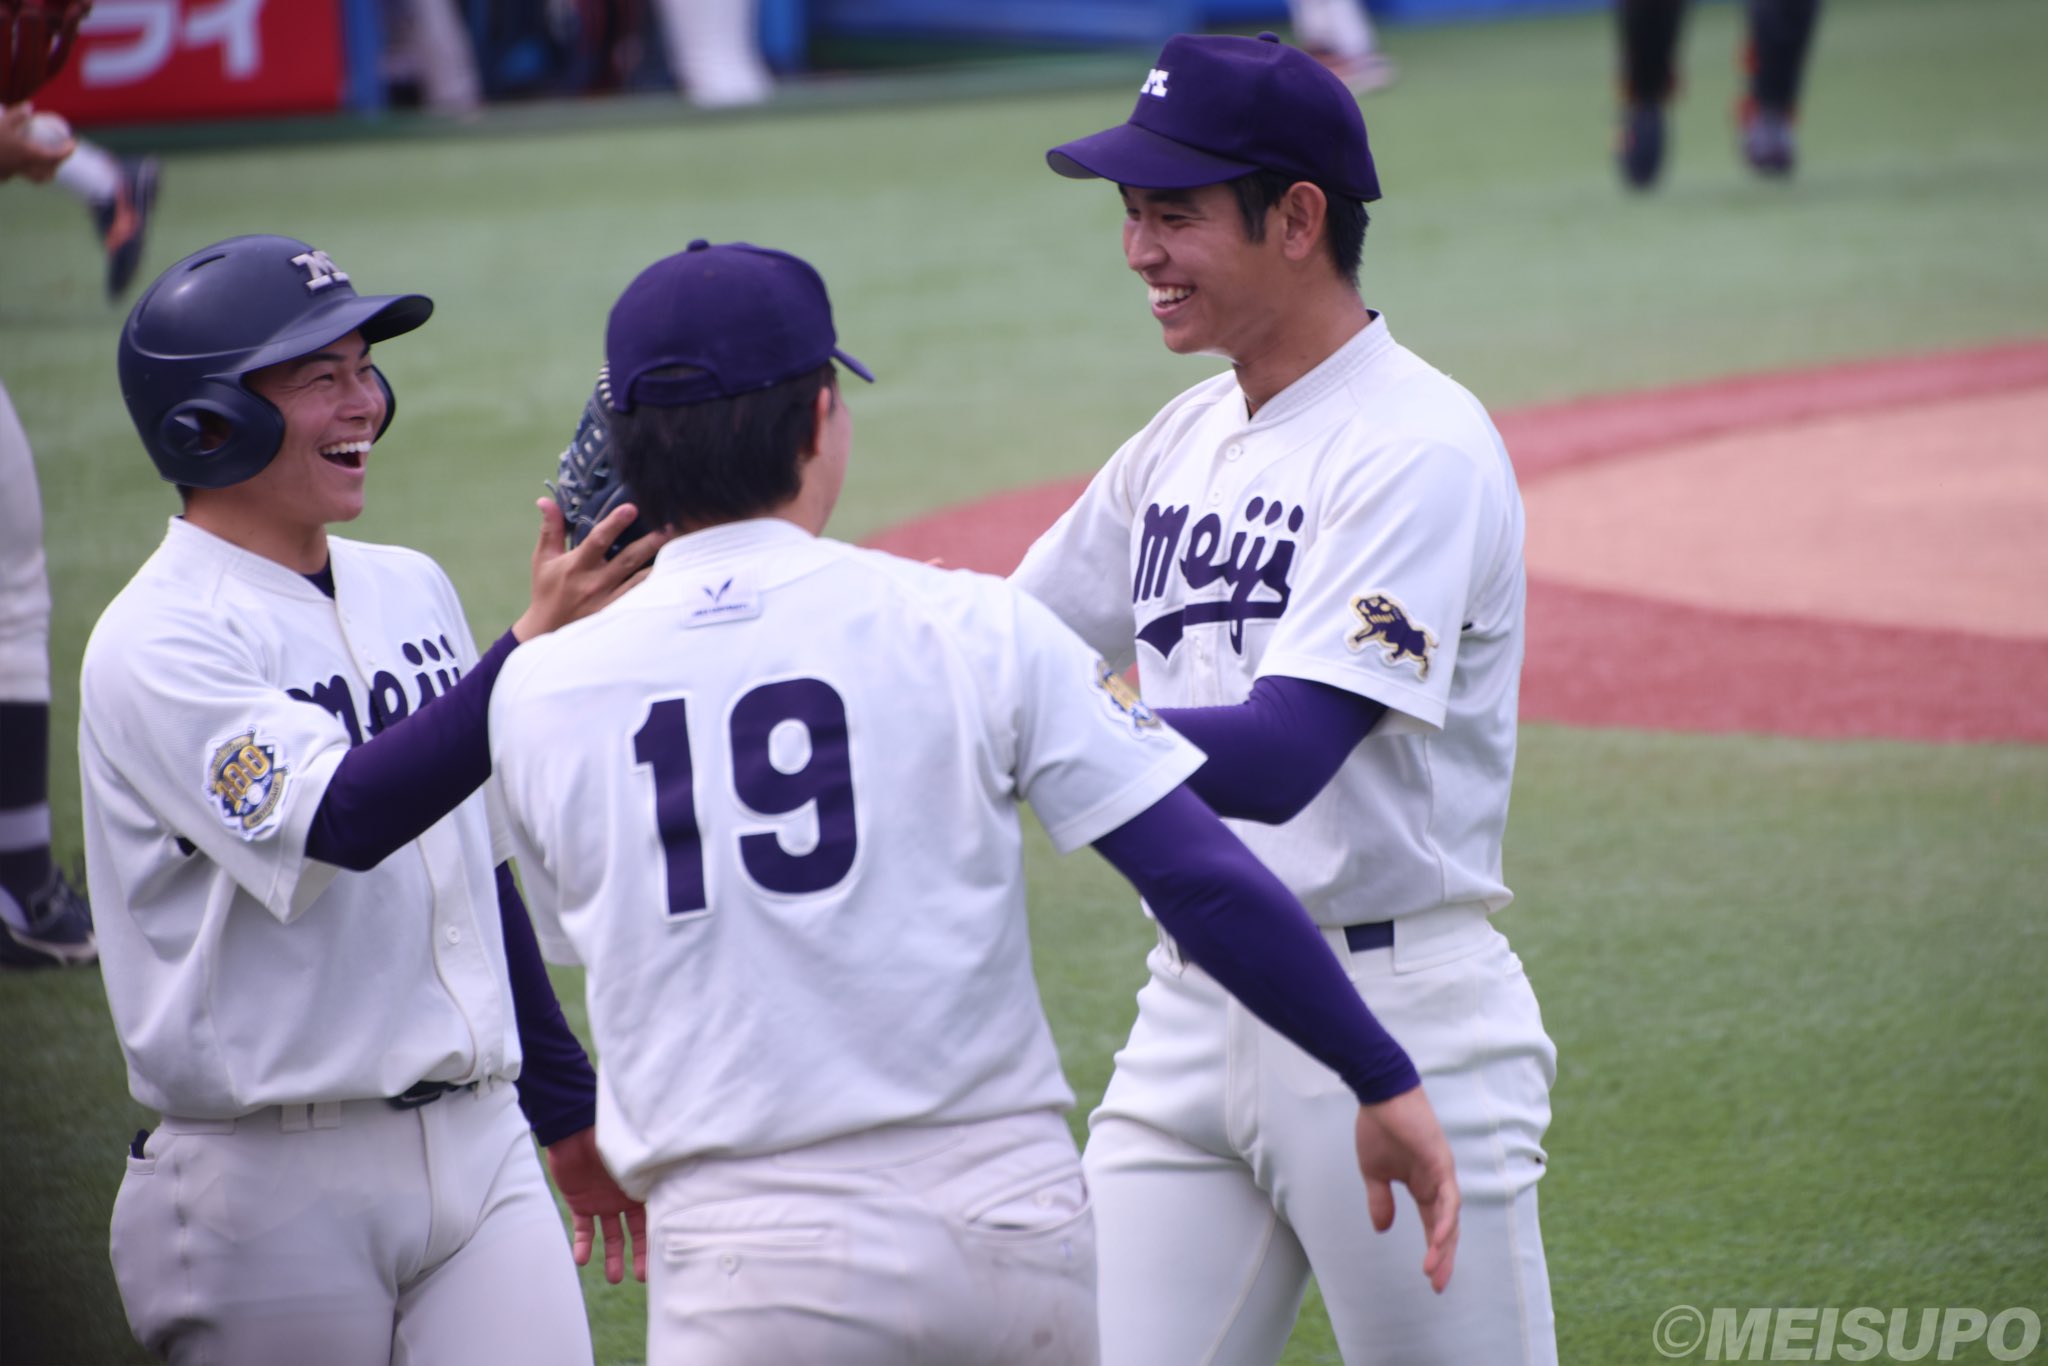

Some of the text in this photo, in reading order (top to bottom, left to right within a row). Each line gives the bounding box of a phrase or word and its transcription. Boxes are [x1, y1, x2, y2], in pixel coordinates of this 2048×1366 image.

[1140, 68, 1169, 97] M
[290, 250, 350, 291] M
[634, 678, 857, 915] 19
